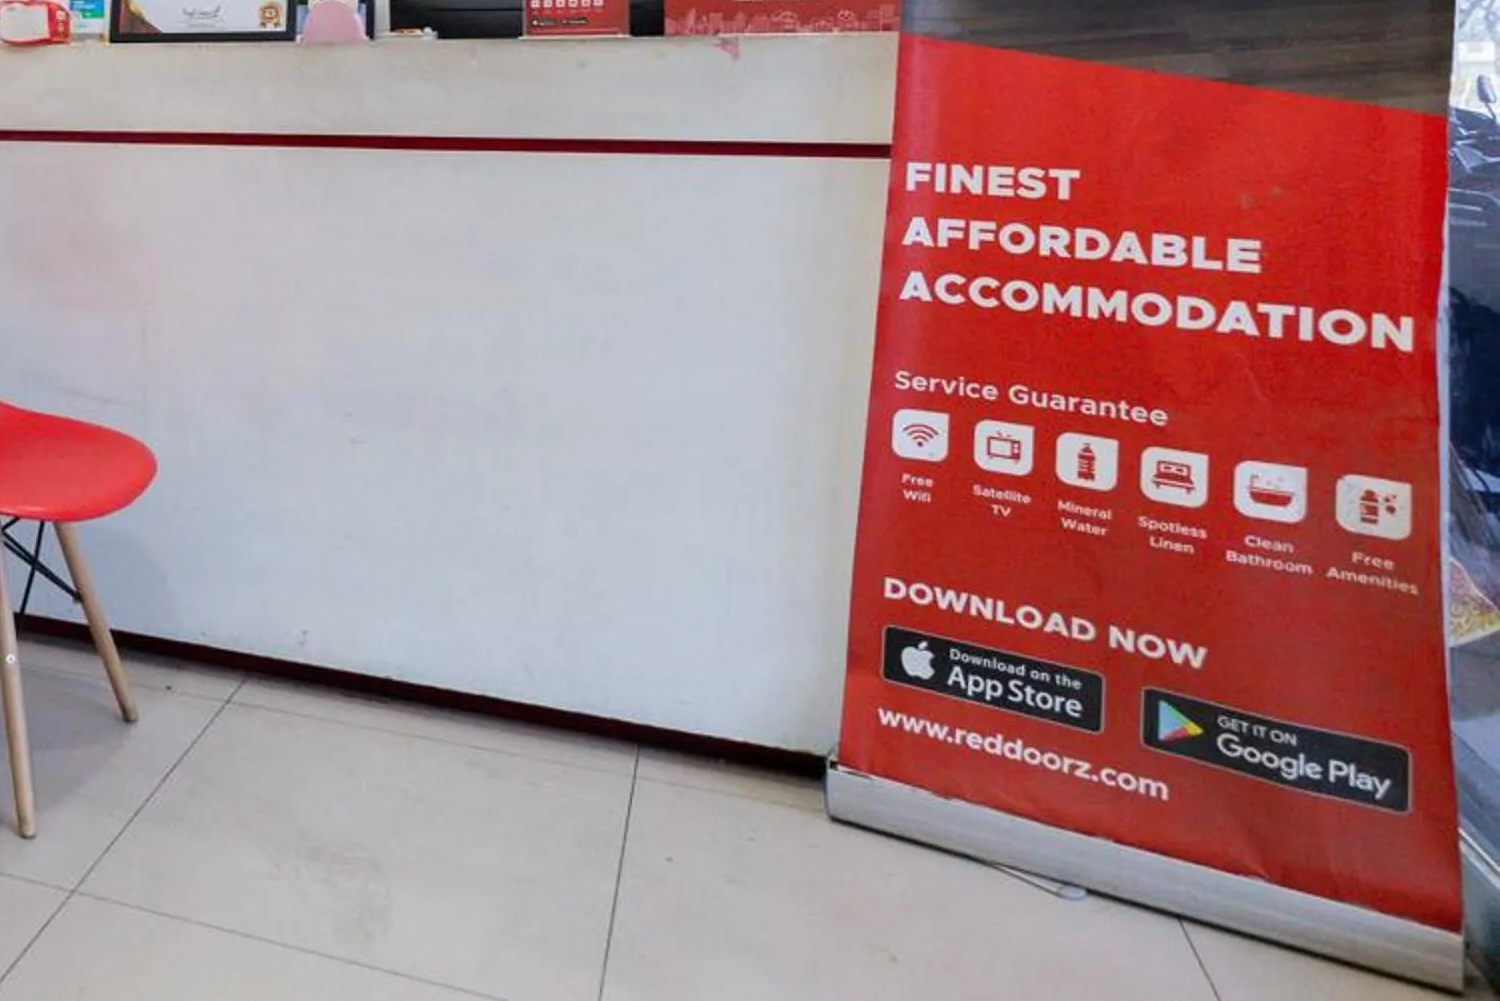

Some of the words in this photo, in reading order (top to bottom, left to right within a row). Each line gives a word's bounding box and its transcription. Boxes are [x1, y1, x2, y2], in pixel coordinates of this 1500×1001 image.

[904, 162, 1081, 200] FINEST
[901, 216, 1263, 274] AFFORDABLE
[899, 270, 1415, 353] ACCOMMODATION
[894, 370, 999, 401] Service
[1008, 384, 1169, 427] Guarantee
[901, 473, 934, 488] Free
[972, 484, 1032, 505] Satellite
[991, 504, 1012, 517] TV
[1057, 500, 1113, 521] Mineral
[1060, 516, 1108, 537] Water
[1138, 515, 1208, 540] Spotless
[1149, 535, 1195, 554] Linen
[1244, 534, 1294, 553] Clean
[1225, 550, 1313, 575] Bathroom
[1351, 551, 1395, 570] Free
[1326, 566, 1420, 596] Amenities
[883, 576, 1097, 642] DOWNLOAD
[1108, 625, 1208, 670] NOW
[949, 648, 1026, 677] Download
[1030, 669, 1050, 683] on
[1055, 672, 1083, 690] the
[947, 666, 1003, 701] App
[1008, 681, 1084, 718] Store
[1217, 715, 1248, 733] GET
[1252, 724, 1267, 737] IT
[1272, 729, 1298, 747] ON
[877, 707, 1170, 801] www.reddoorz.com
[1216, 733, 1322, 780] Google
[1329, 760, 1392, 799] Play
